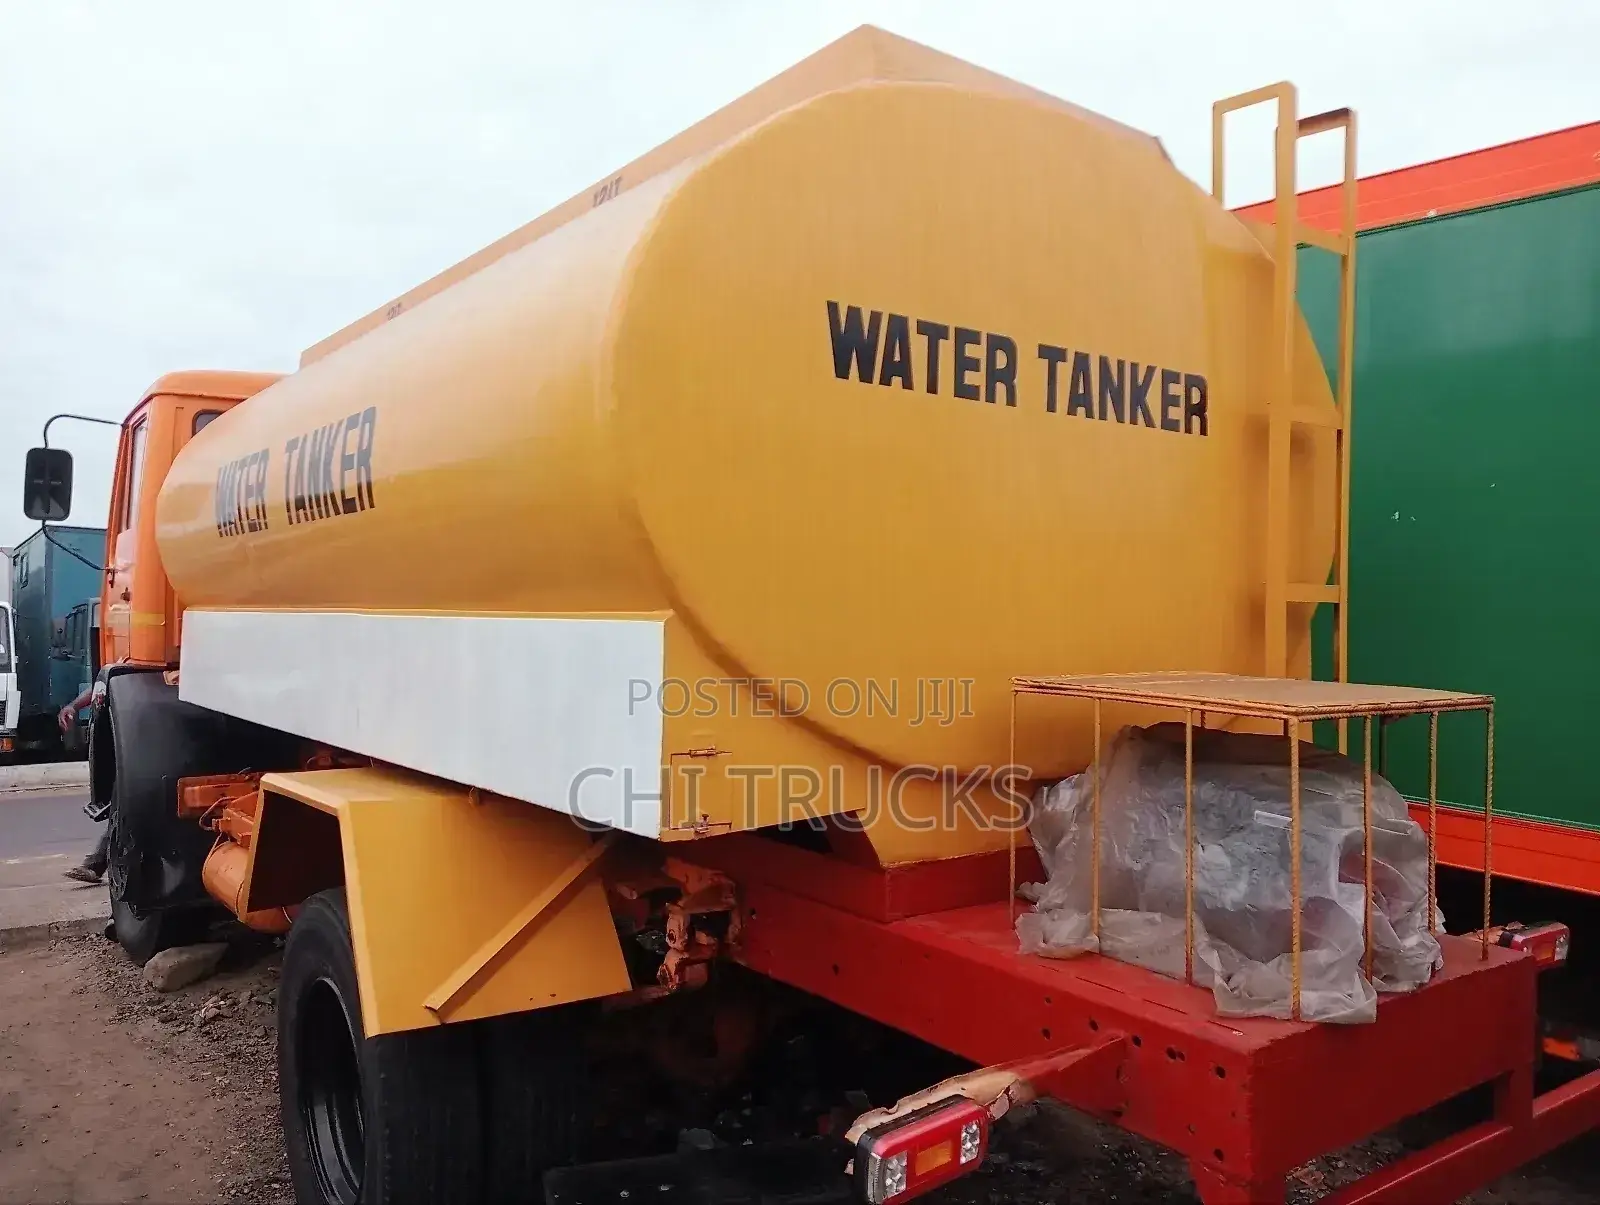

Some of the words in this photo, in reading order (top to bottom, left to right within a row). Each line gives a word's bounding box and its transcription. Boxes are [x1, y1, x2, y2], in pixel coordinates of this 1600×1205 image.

[826, 300, 1018, 408] WATER
[1036, 343, 1209, 437] TANKER
[215, 448, 270, 538] WATER
[285, 406, 377, 526] TANKER
